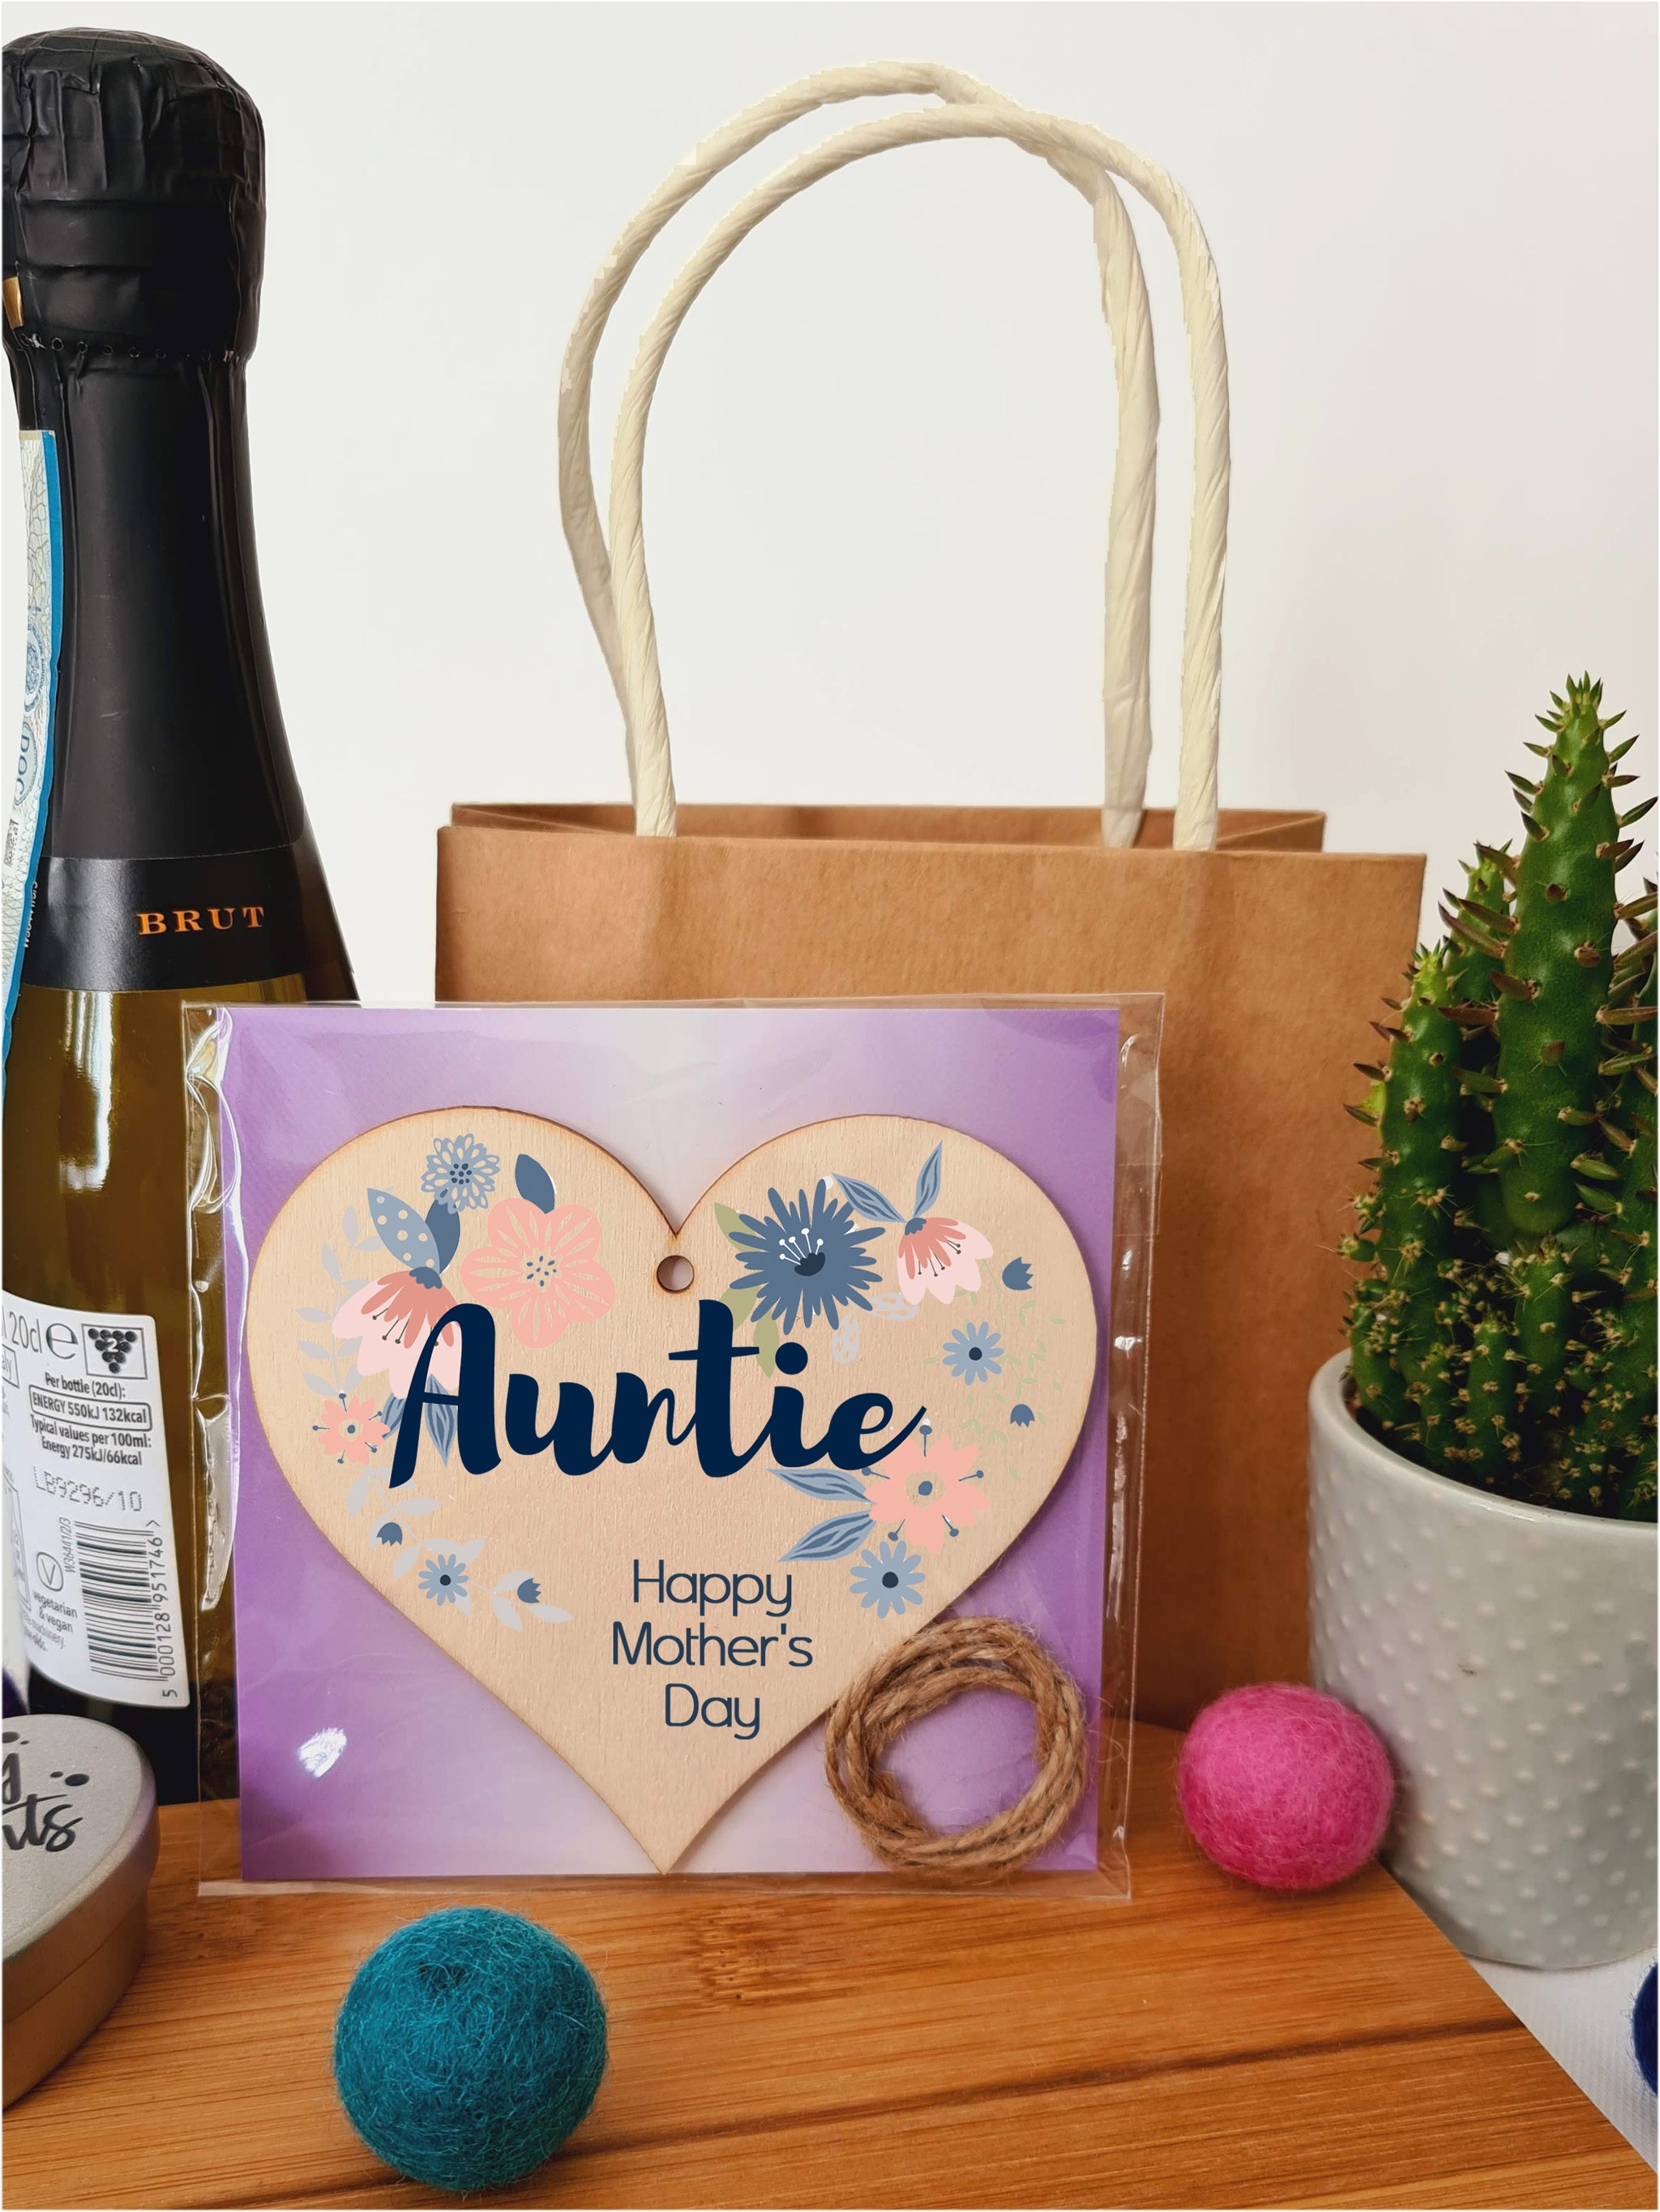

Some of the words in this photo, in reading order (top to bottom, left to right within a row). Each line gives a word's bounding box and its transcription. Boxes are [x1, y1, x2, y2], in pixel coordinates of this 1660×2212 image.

[136, 906, 264, 935] BRUT
[9, 1311, 42, 1354] 20cl
[45, 1371, 59, 1388] Per
[61, 1375, 90, 1394] bottle
[92, 1380, 126, 1401] (20cl):
[389, 1299, 927, 1488] Auntie
[32, 1392, 66, 1414] ENERGY
[67, 1401, 100, 1420] 550kJ
[102, 1407, 147, 1423] 132kcal
[30, 1414, 58, 1435] Typical
[59, 1425, 90, 1443] values
[92, 1432, 109, 1447] per
[111, 1432, 152, 1448] 100ml:
[41, 1435, 71, 1460] Energy
[72, 1444, 143, 1465] 275kJ/66kcal
[149, 1537, 168, 1603] 951746
[32, 1591, 78, 1619] vegetarian
[633, 1559, 792, 1617] Happy
[45, 1613, 74, 1633] vegan
[154, 1611, 176, 1677] 000128
[613, 1621, 813, 1666] Mother's
[162, 1688, 178, 1698] 5
[665, 1683, 760, 1739] Day
